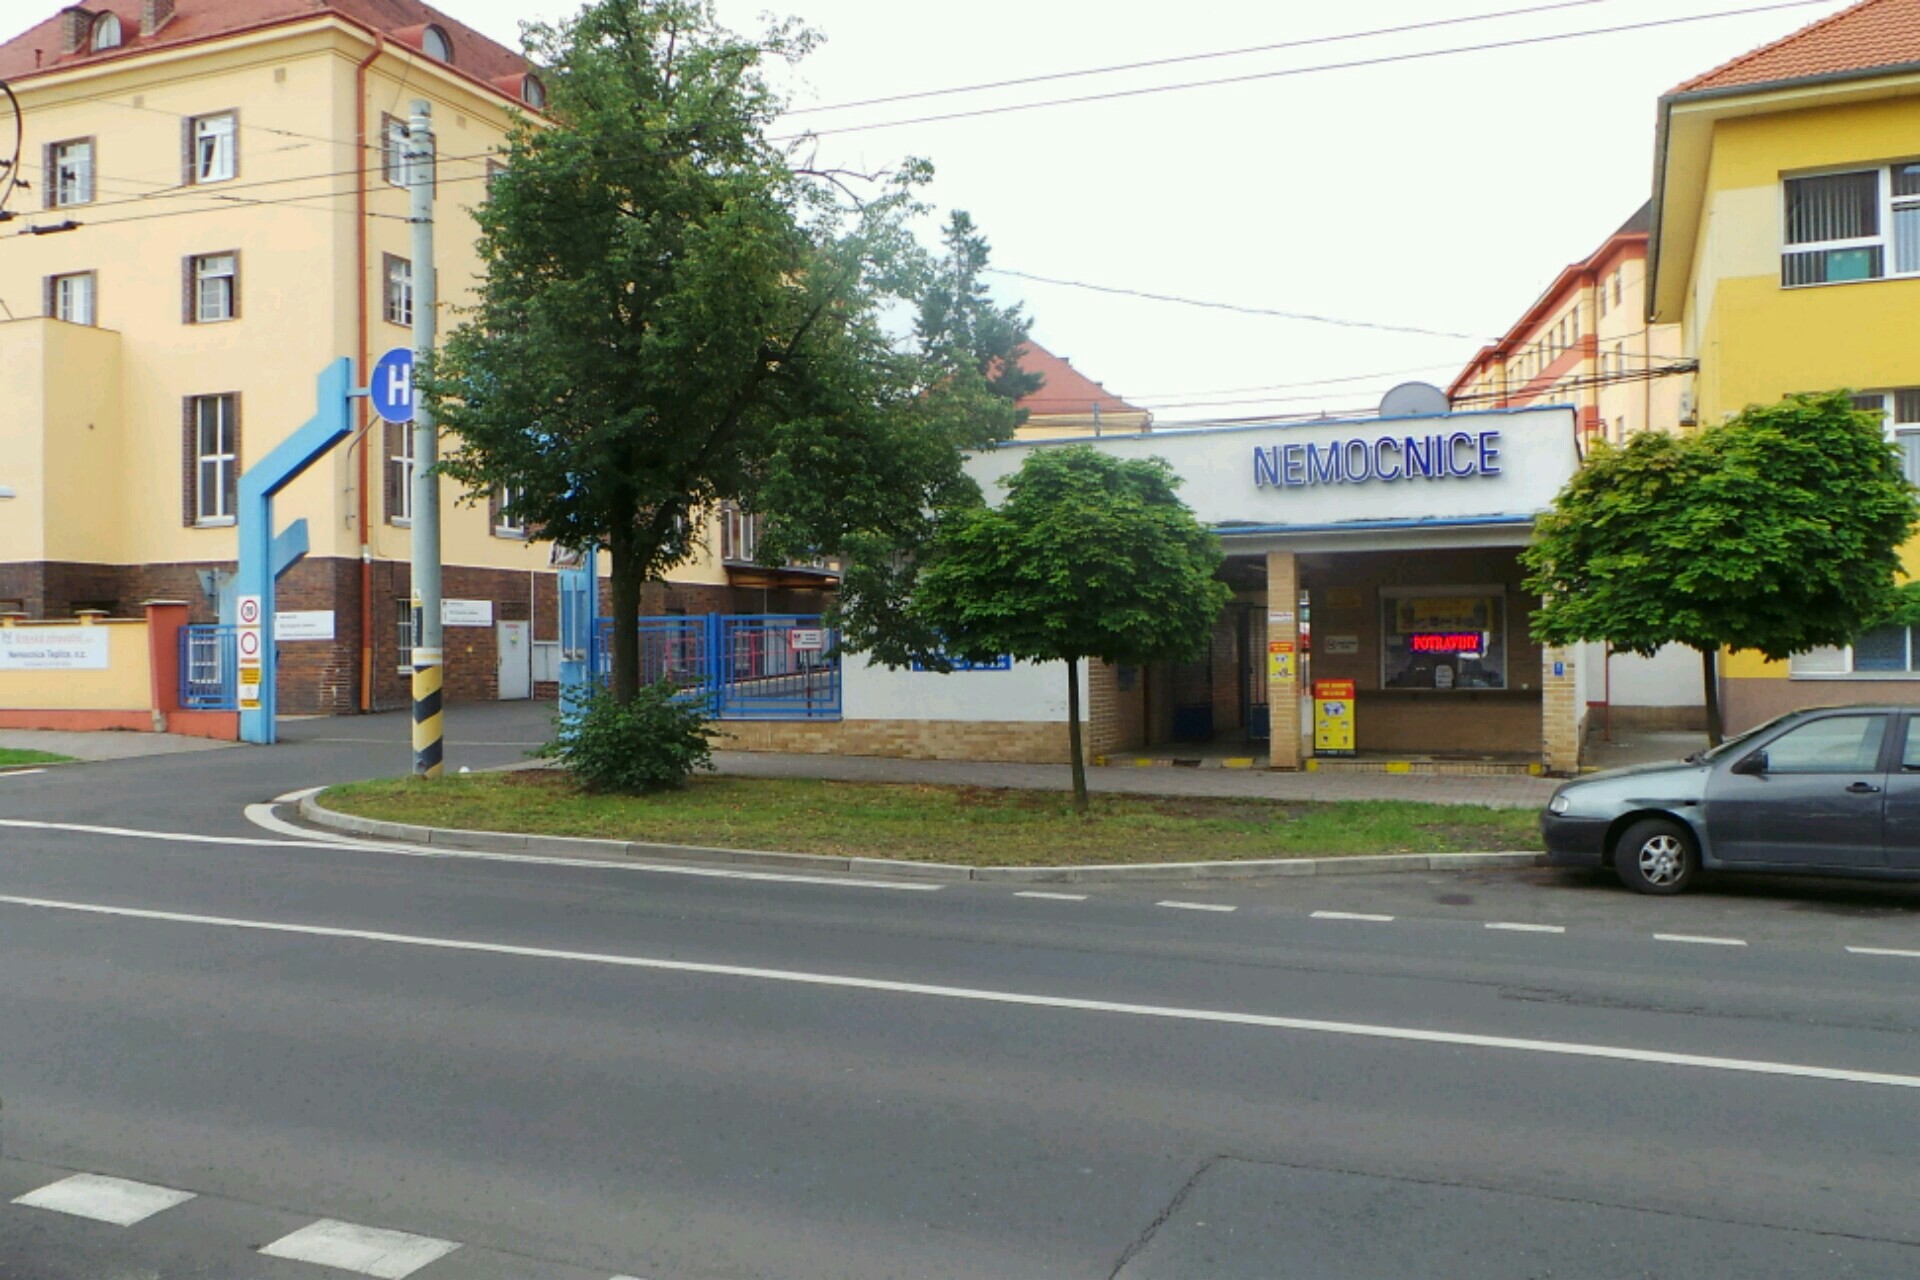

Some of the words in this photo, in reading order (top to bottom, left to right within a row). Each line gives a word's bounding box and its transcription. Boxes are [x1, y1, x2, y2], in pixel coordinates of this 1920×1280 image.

[388, 363, 410, 406] H
[1253, 431, 1501, 488] NEMOCNICE
[1413, 634, 1479, 651] POTRAVINY
